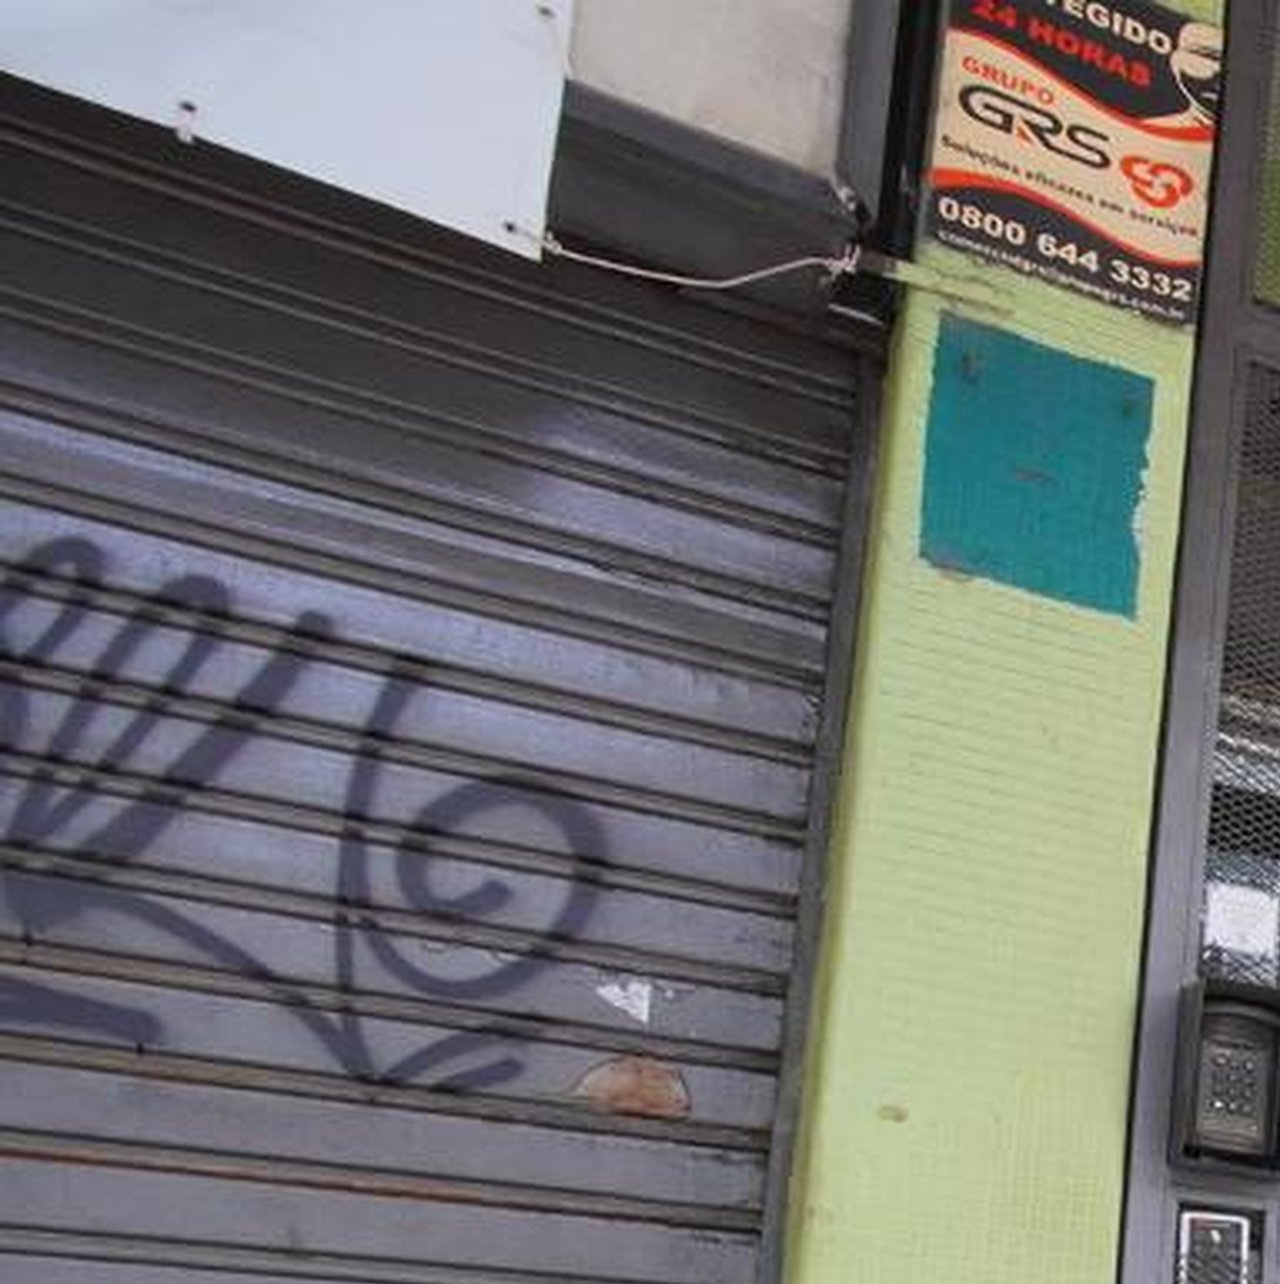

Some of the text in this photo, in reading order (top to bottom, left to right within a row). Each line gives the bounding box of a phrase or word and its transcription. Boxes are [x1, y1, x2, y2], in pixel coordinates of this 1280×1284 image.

[968, 0, 1150, 88] 24 HORAS
[1046, 0, 1172, 55] EGIDO
[962, 56, 1056, 106] GRUPO
[957, 84, 1111, 170] GRS
[937, 196, 1193, 302] 0800 644 3332
